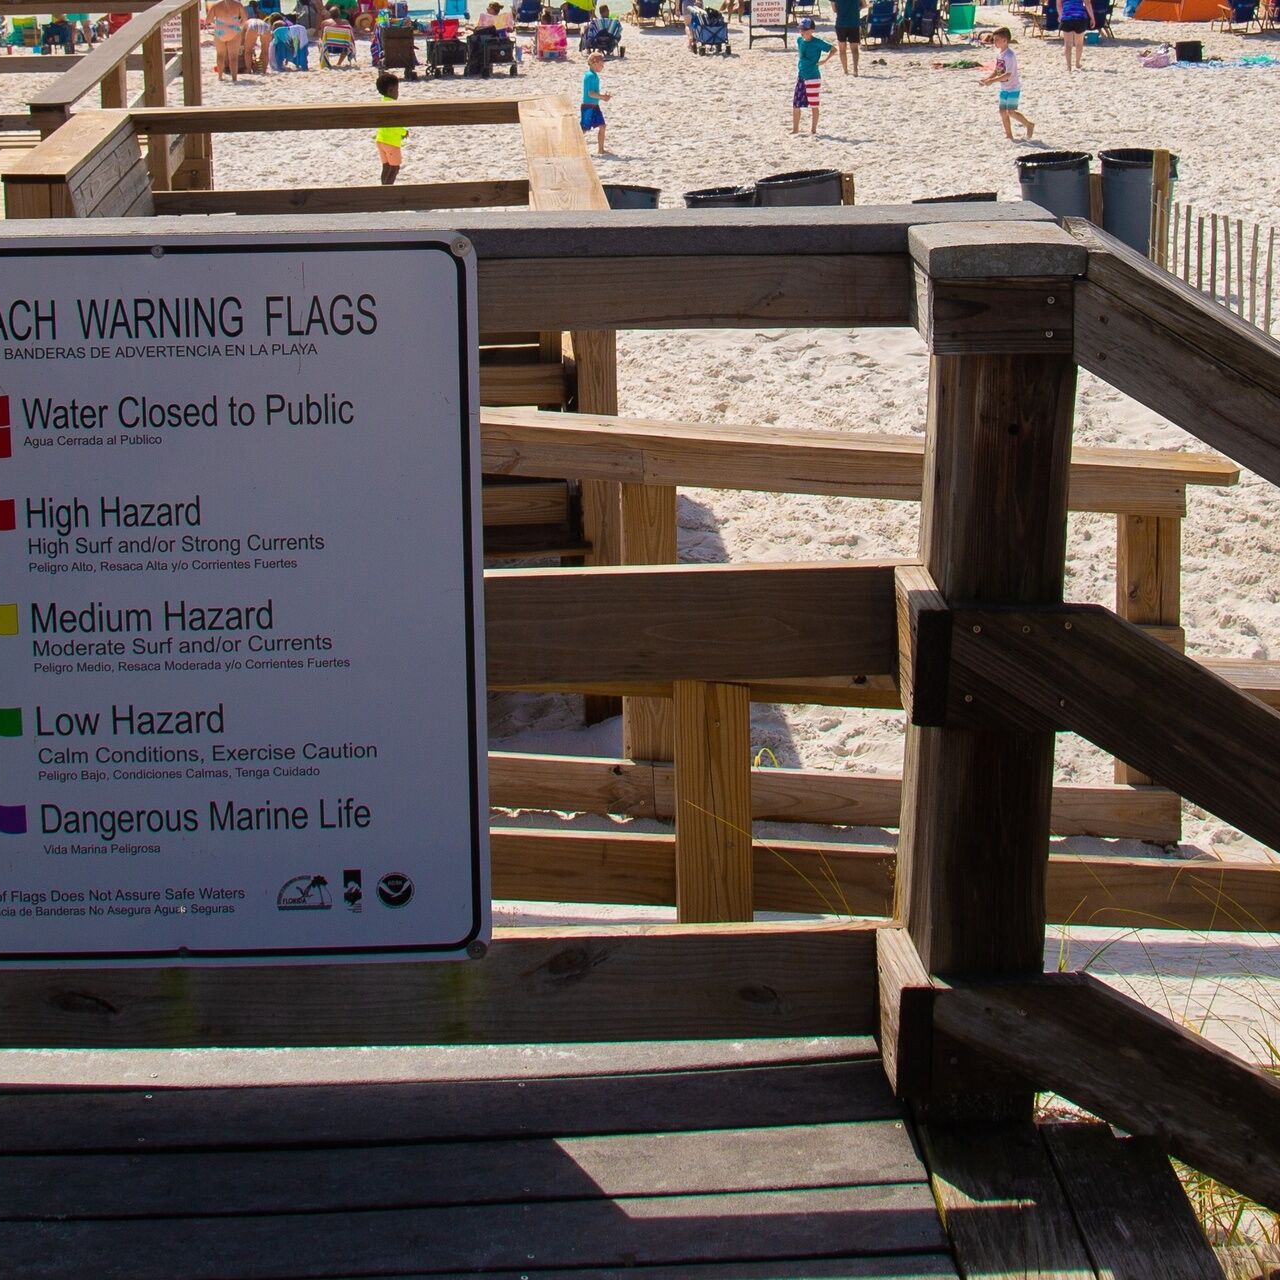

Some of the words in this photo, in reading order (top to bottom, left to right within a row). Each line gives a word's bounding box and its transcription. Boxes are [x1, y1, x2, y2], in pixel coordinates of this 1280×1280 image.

[76, 296, 243, 340] WARNING
[266, 293, 378, 337] FLAGS
[4, 346, 86, 360] BANDERAS
[90, 346, 111, 359] DE
[115, 344, 222, 358] ADVERTENCIA
[225, 344, 245, 357] EN
[250, 343, 269, 356] LA
[271, 343, 318, 356] PLAYA
[21, 397, 109, 430] Water
[118, 395, 218, 429] Closed
[228, 396, 256, 427] to
[266, 392, 354, 426] Public
[23, 436, 54, 449] Agua
[57, 435, 103, 446] Cerrada
[106, 435, 117, 445] al
[120, 434, 162, 445] Publico
[26, 497, 89, 537] High
[100, 495, 201, 528] Hazard
[28, 537, 69, 559] High
[75, 536, 113, 554] Surf
[118, 535, 176, 554] and/or
[182, 535, 240, 556] Strong
[247, 534, 325, 552] Currents
[29, 562, 68, 575] Peligro
[71, 562, 96, 573] Alto,
[100, 561, 143, 572] Resaca
[145, 560, 168, 571] Alta
[171, 560, 189, 573] y/o
[191, 559, 251, 570] Corrientes
[254, 558, 298, 569] Fuertes
[31, 601, 152, 634] Medium
[164, 599, 273, 632] Hazard
[33, 639, 125, 657] Moderate
[132, 637, 173, 655] Surf
[179, 635, 242, 654] and/or
[248, 634, 332, 652] Currents
[34, 662, 73, 675] Peligro
[77, 661, 114, 673] Medio,
[118, 661, 161, 672] Resaca
[164, 660, 222, 671] Moderada
[225, 659, 242, 672] y/o
[245, 658, 304, 669] Corrientes
[307, 657, 350, 668] Fuertes
[36, 706, 100, 737] Low
[112, 703, 224, 735] Hazard
[38, 747, 89, 765] Calm
[95, 746, 204, 765] Conditions,
[212, 744, 296, 762] Exercise
[302, 742, 377, 760] Caution
[38, 770, 78, 783] Peligro
[81, 769, 109, 783] Bajo,
[113, 769, 182, 780] Condiciones
[185, 768, 232, 779] Calmas,
[235, 767, 270, 780] Tenga
[273, 766, 320, 777] Cuidado
[41, 804, 199, 842] Dangerous
[210, 800, 308, 831] Marine
[320, 797, 371, 829] Life
[43, 844, 68, 855] Vida
[71, 844, 107, 854] Marina
[111, 843, 161, 856] Peligrosa
[11, 890, 47, 906] Flags
[51, 890, 85, 902] Does
[89, 889, 112, 901] Not
[115, 889, 161, 901] Assure
[165, 887, 195, 901] Safe
[198, 887, 245, 900] Waters
[19, 906, 32, 917] de
[35, 906, 86, 916] Banderas
[89, 905, 104, 916] No
[107, 905, 151, 917] Asegura
[191, 904, 235, 916] Seguras
